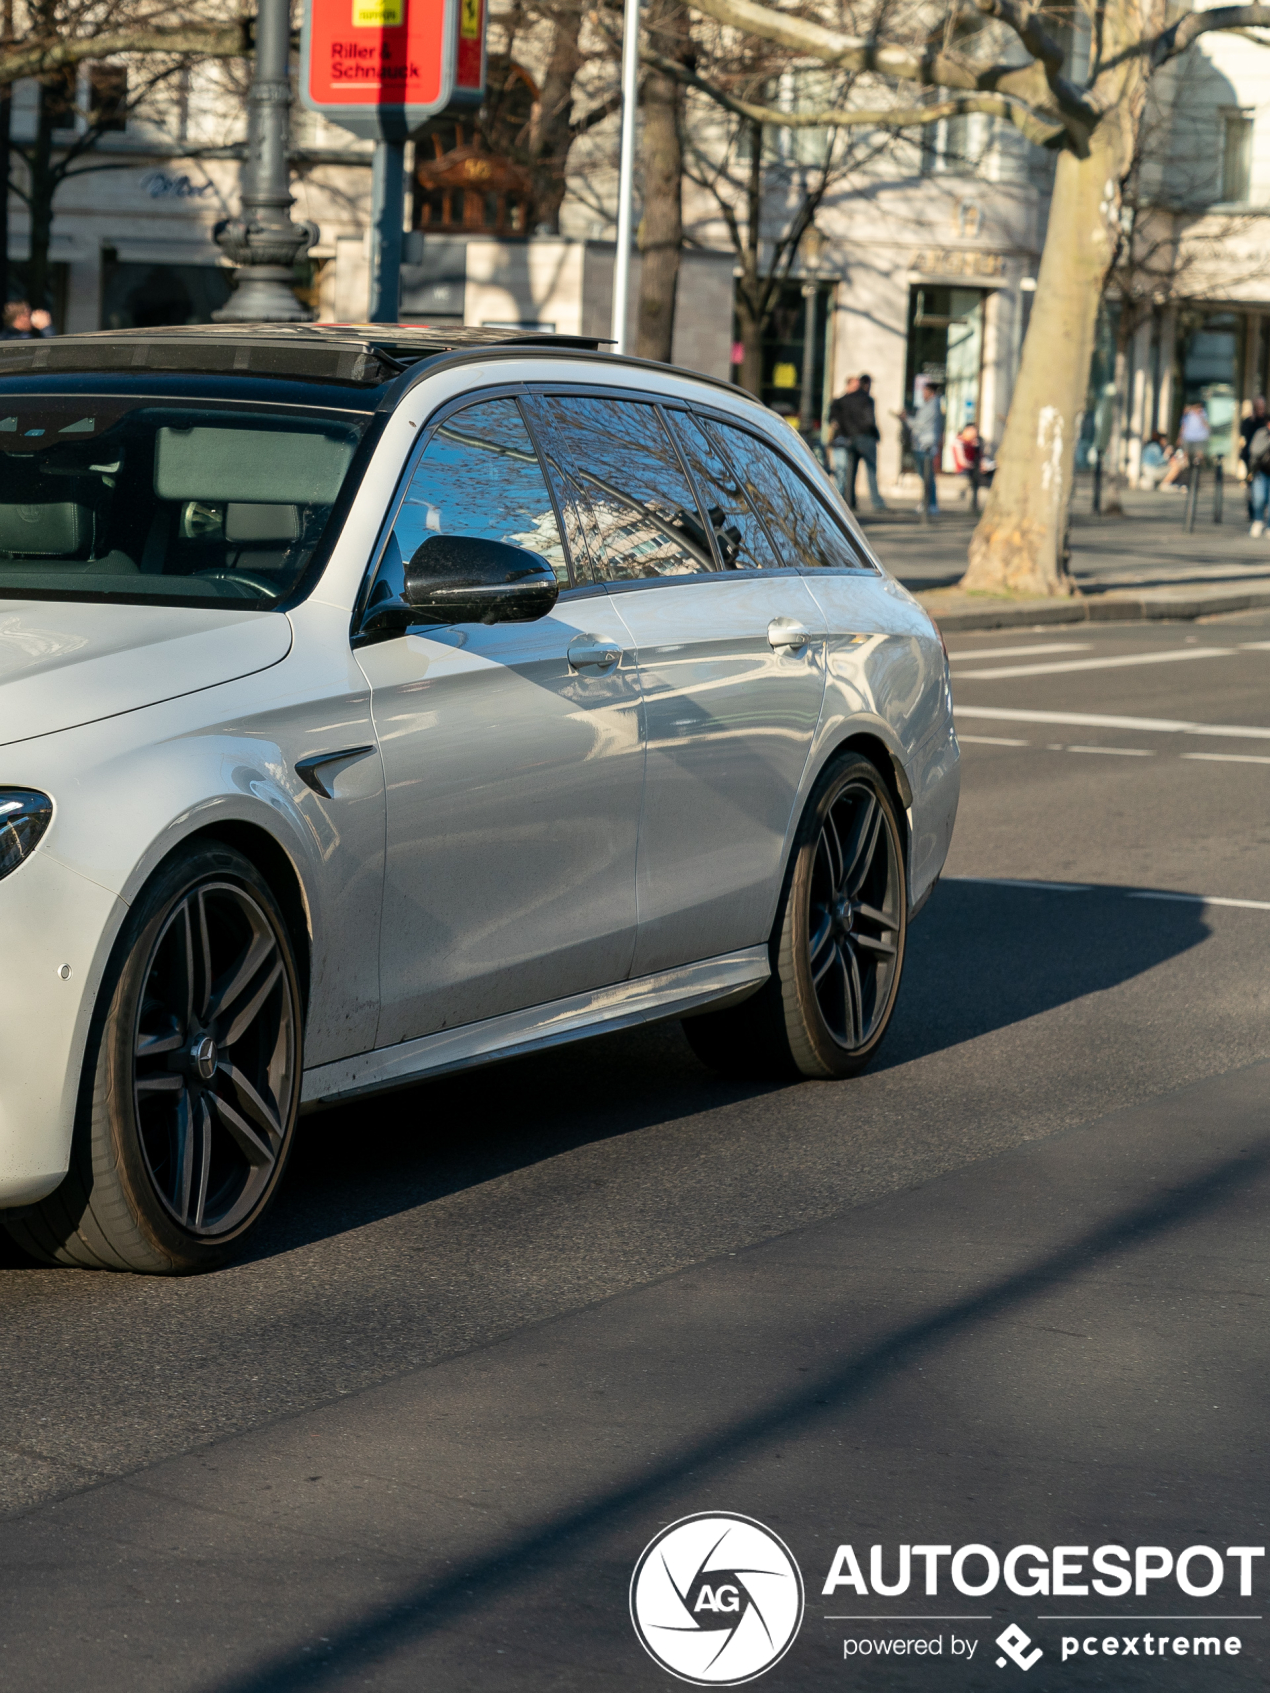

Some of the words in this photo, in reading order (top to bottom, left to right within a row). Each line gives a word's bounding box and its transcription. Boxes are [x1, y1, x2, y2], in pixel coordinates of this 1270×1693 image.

[331, 43, 375, 60] Riller
[380, 43, 391, 60] &
[331, 62, 420, 80] Schnauck
